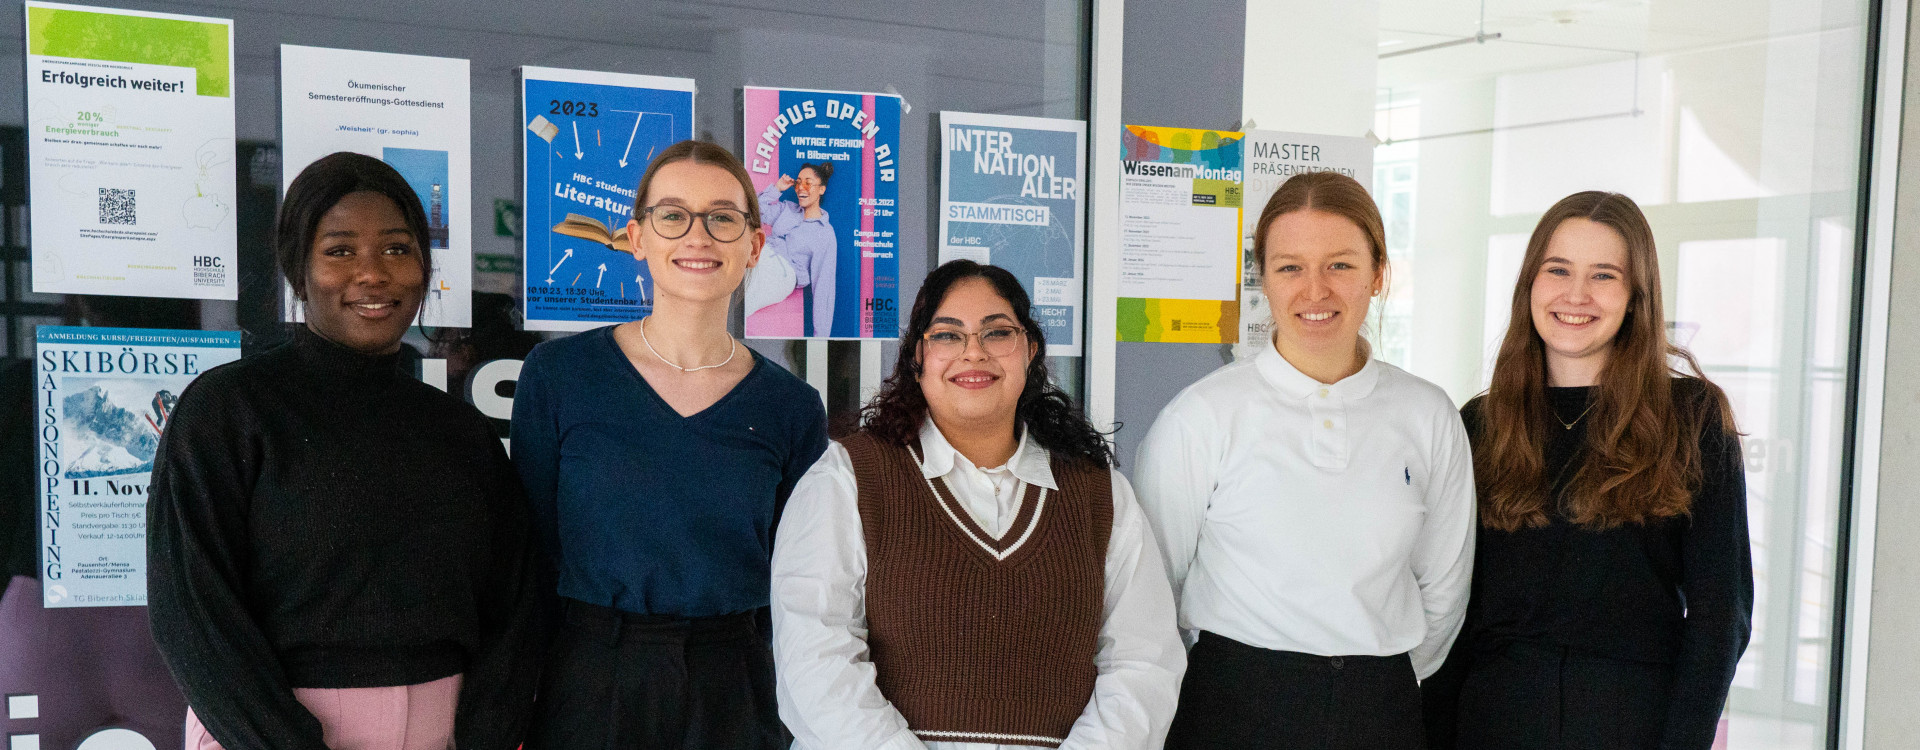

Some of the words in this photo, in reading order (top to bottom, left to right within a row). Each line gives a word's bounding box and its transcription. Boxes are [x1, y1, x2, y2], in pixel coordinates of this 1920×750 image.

[42, 69, 127, 88] Erfolgreich
[131, 79, 184, 93] weiter!
[348, 79, 406, 92] Ökumenischer
[308, 92, 445, 109] Semestereröffnungs-Gottesdienst
[549, 99, 599, 118] 2023
[77, 111, 91, 121] 20
[45, 125, 119, 138] Energieverbrauch
[377, 127, 390, 135] (gr.
[391, 129, 419, 137] sophia)
[752, 100, 817, 174] CAMPUS
[826, 99, 880, 140] OPEN
[874, 143, 895, 182] AIR
[791, 136, 827, 147] VINTAGE
[828, 138, 865, 149] FASHION
[949, 128, 1013, 154] INTER
[807, 150, 850, 161] Biberach
[1253, 141, 1320, 161] MASTER
[974, 151, 1055, 177] NATION
[572, 172, 593, 185] HBC
[1020, 174, 1076, 200] ALER
[858, 198, 894, 206] 24.05.2023
[949, 205, 1045, 222] STAMMTISCH
[854, 229, 880, 238] Campus
[854, 240, 893, 248] Hochschule
[951, 236, 964, 244] der
[964, 236, 981, 245] HBC
[194, 255, 225, 268] HBC.
[544, 296, 577, 304] unserer
[580, 297, 638, 306] Studentenbar
[865, 298, 897, 311] HBC.
[1041, 308, 1067, 316] HECHT
[48, 333, 99, 341] ANMELDUNG
[101, 334, 230, 344] KURSE/FREIZEITEN/AUSFAHRTEN
[42, 347, 199, 375] SKIBÖRSE
[68, 501, 147, 509] Selbstverkäuferflohmar
[126, 593, 147, 601] Skiab
